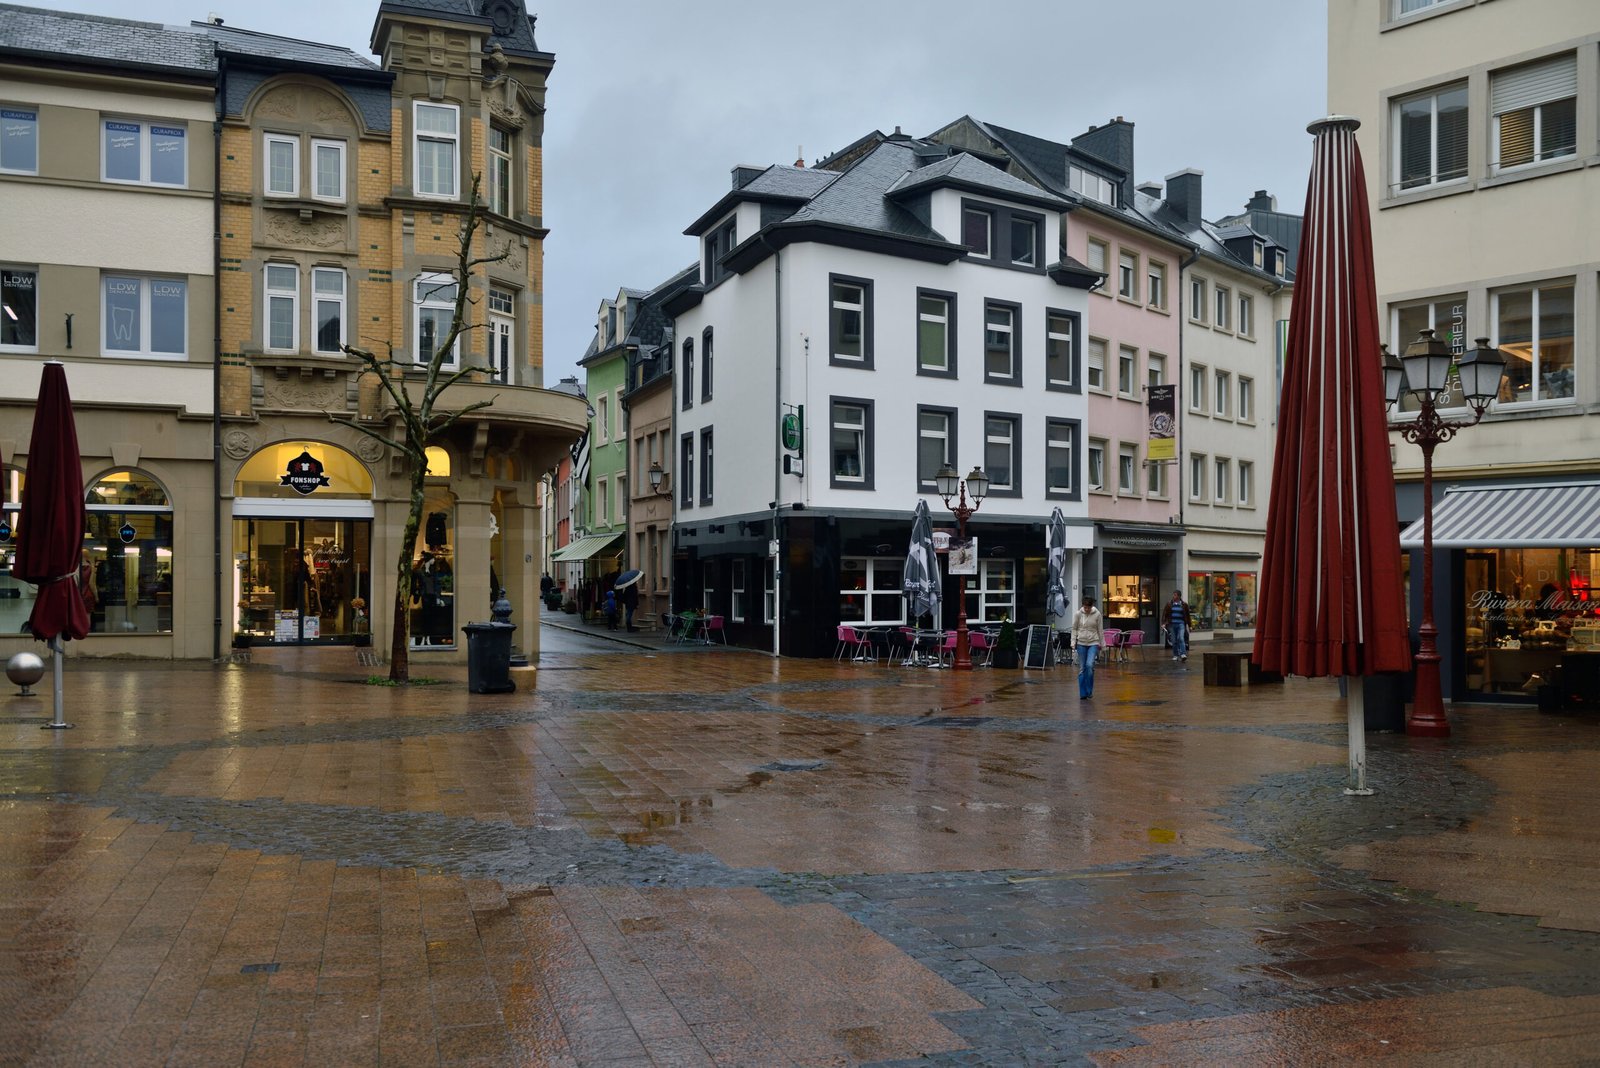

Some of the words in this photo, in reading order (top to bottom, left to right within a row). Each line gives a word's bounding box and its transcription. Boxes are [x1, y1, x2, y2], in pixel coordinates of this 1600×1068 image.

[3, 111, 33, 119] CURAPROX
[108, 123, 138, 131] CURAPROX
[153, 128, 182, 136] CURAPROX
[3, 275, 33, 285] LDW
[109, 282, 137, 291] LDW
[153, 285, 181, 294] LDW
[290, 476, 321, 484] FONSHOP
[1535, 590, 1600, 611] Maison
